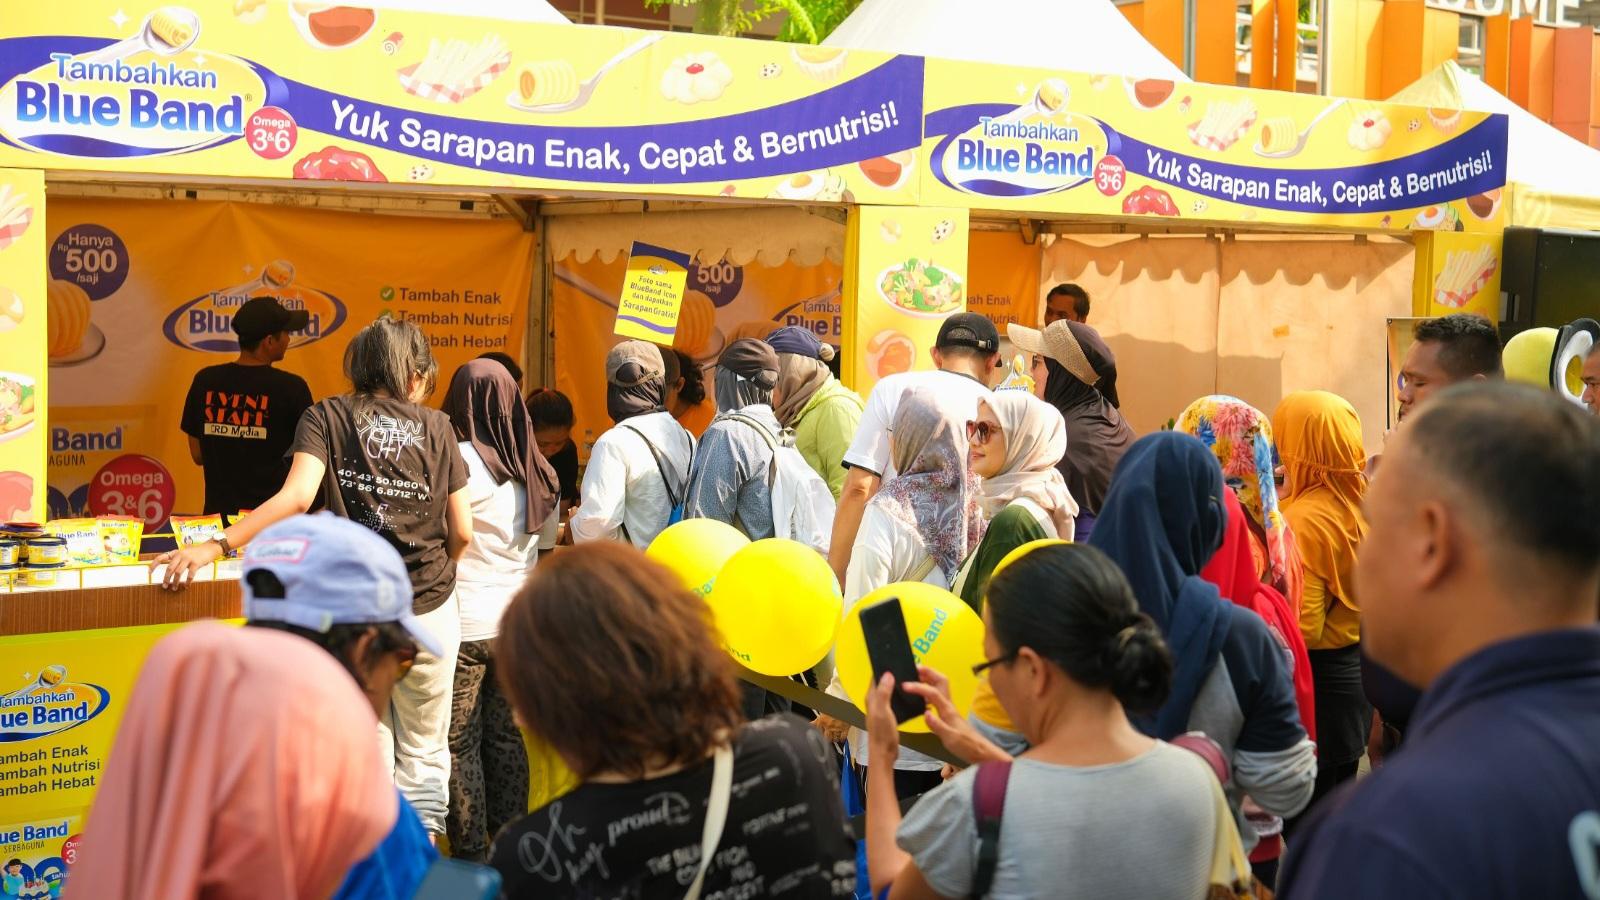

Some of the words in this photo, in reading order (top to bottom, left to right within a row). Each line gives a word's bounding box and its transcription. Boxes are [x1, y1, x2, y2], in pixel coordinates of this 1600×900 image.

[52, 55, 217, 88] Tambahkan
[16, 81, 120, 128] Blue
[130, 88, 243, 134] Band
[252, 115, 291, 129] Omega
[980, 117, 1079, 141] Tambahkan
[331, 99, 391, 142] Yuk
[399, 118, 535, 166] Sarapan
[545, 139, 630, 174] Enak,
[638, 138, 727, 174] Cepat
[734, 137, 755, 162] &
[760, 100, 900, 155] Bernutrisi!
[958, 139, 1020, 172] Blue
[1025, 144, 1093, 178] Band
[1146, 149, 1182, 181] Yuk
[1187, 163, 1270, 200] Sarapan
[1275, 178, 1328, 208] Enak,
[1332, 180, 1385, 207] Cepat
[1390, 177, 1404, 198] &
[1407, 149, 1494, 195] Bernutrisi!
[68, 233, 114, 248] Hanya
[65, 250, 117, 273] 500
[76, 272, 100, 284] /saji
[638, 275, 654, 285] Foto
[697, 265, 735, 284] 500
[400, 287, 460, 303] Tambah
[464, 290, 502, 304] Enak
[986, 294, 1011, 305] Enak
[803, 300, 840, 314] Tamba
[189, 310, 232, 334] Blu
[398, 310, 459, 325] Tambah
[464, 312, 513, 326] Nutrisi
[463, 334, 507, 348] Hebat
[52, 427, 122, 451] Band
[231, 426, 260, 437] Media
[49, 454, 86, 466] AGUNA
[100, 471, 164, 488] Omega
[912, 607, 948, 655] Band
[33, 702, 88, 725] Band
[52, 744, 88, 759] Enak
[52, 758, 100, 775] Nutrisi
[52, 775, 96, 791] Hebat
[24, 821, 68, 841] Band
[4, 841, 45, 853] SERBAGUNA
